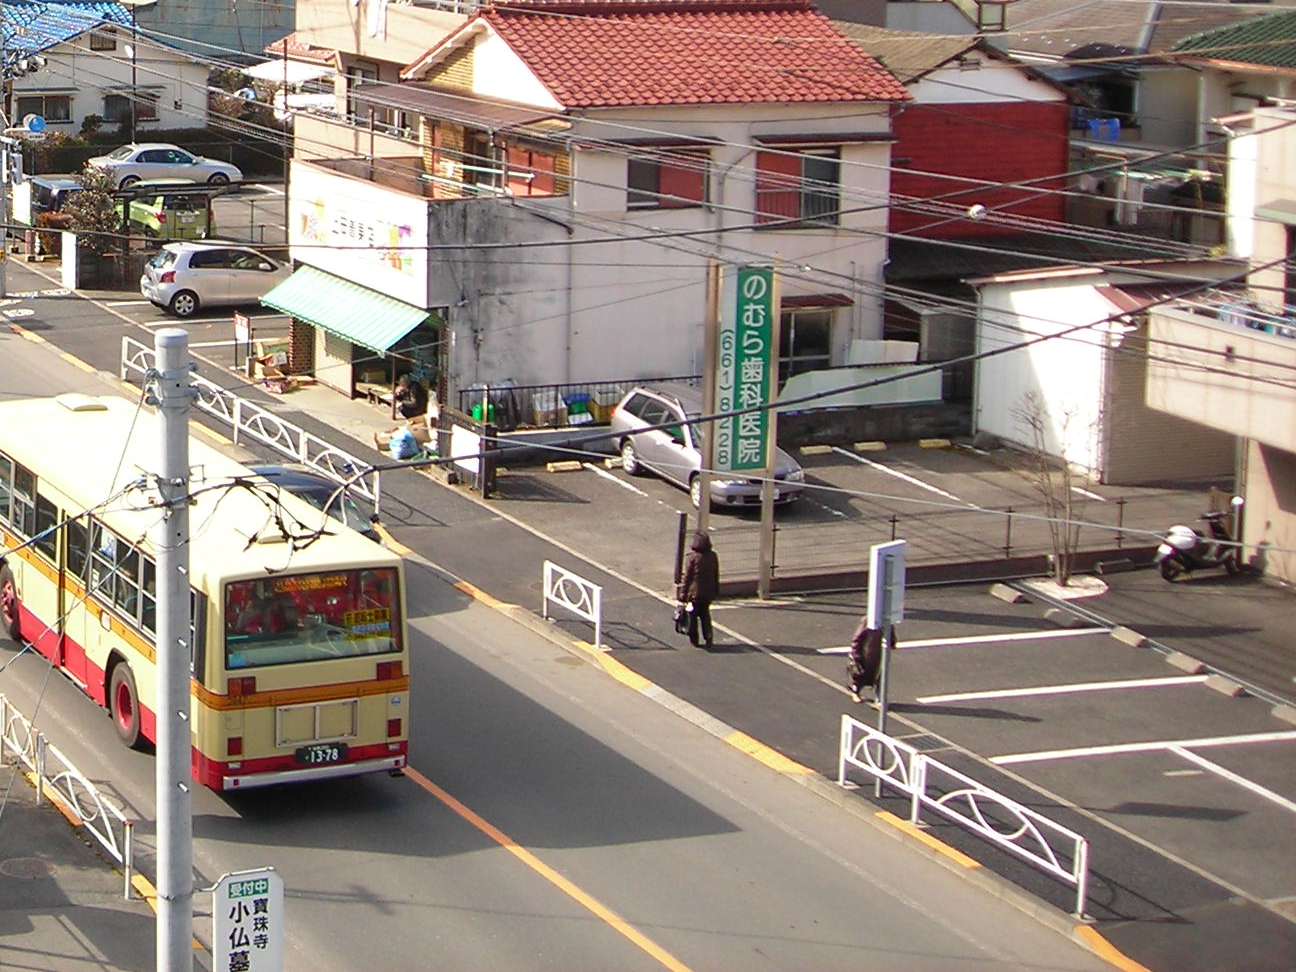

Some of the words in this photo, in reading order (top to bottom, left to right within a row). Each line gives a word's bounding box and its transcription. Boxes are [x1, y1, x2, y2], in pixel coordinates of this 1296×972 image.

[737, 275, 767, 464] のむら歯科医院
[230, 880, 267, 898] 受付中
